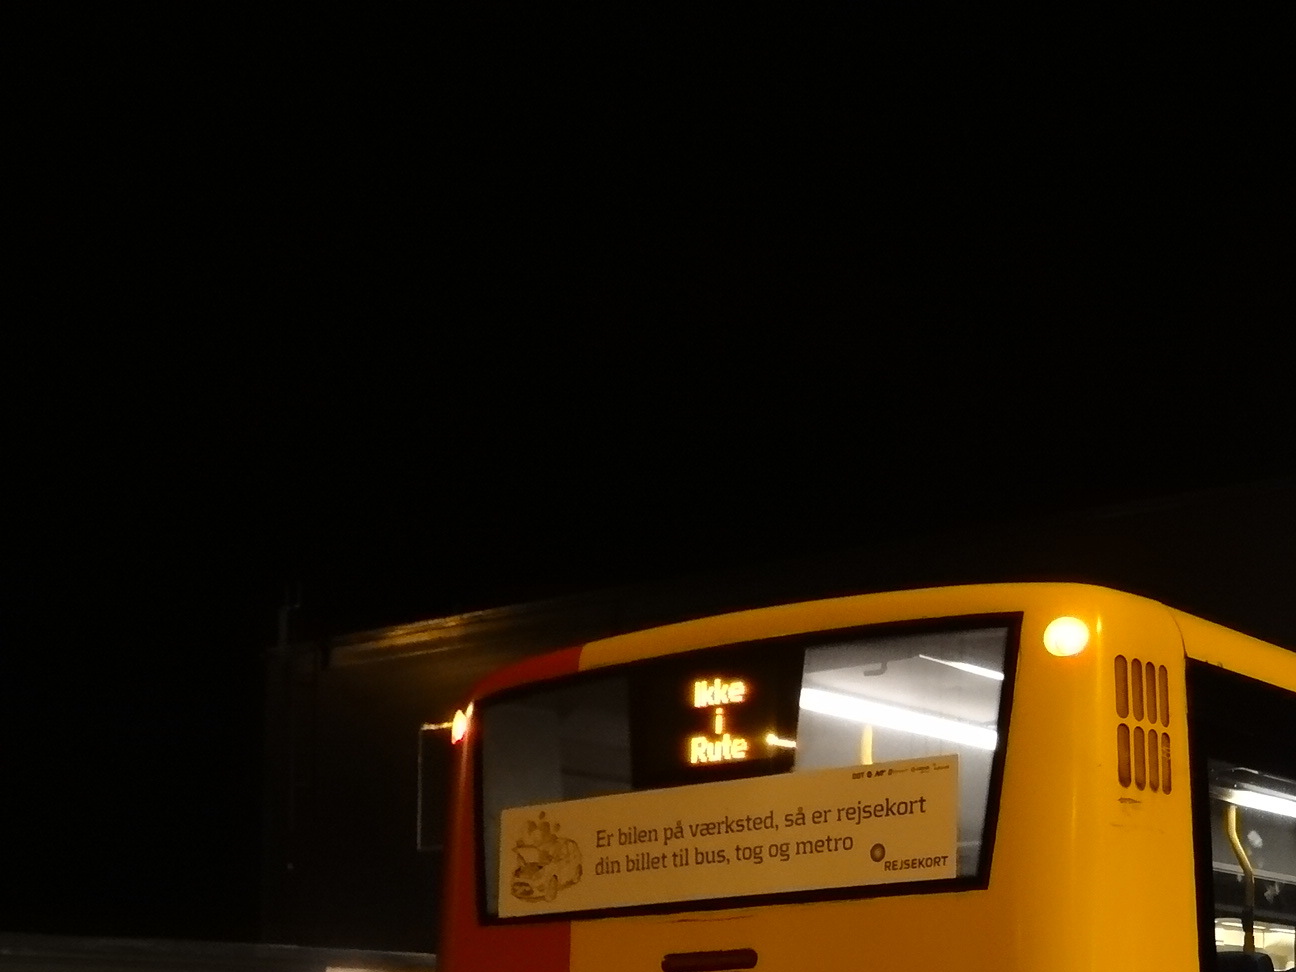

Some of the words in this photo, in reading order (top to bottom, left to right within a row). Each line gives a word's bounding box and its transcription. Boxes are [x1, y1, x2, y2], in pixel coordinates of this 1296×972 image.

[693, 678, 746, 708] Ikke
[714, 707, 724, 735] i
[690, 733, 749, 764] Rute
[596, 829, 614, 848] Er
[618, 826, 658, 846] bilen
[663, 820, 685, 845] på
[689, 810, 779, 838] værksted,
[784, 806, 806, 828] så
[811, 809, 832, 825] er
[836, 796, 927, 826] rejsekort
[595, 856, 621, 876] din
[625, 852, 668, 873] billet
[671, 848, 689, 868] til
[694, 846, 730, 866] bus,
[734, 844, 764, 865] tog
[768, 842, 790, 862] og
[795, 835, 854, 856] metro
[884, 855, 949, 872] REJSEKORT
